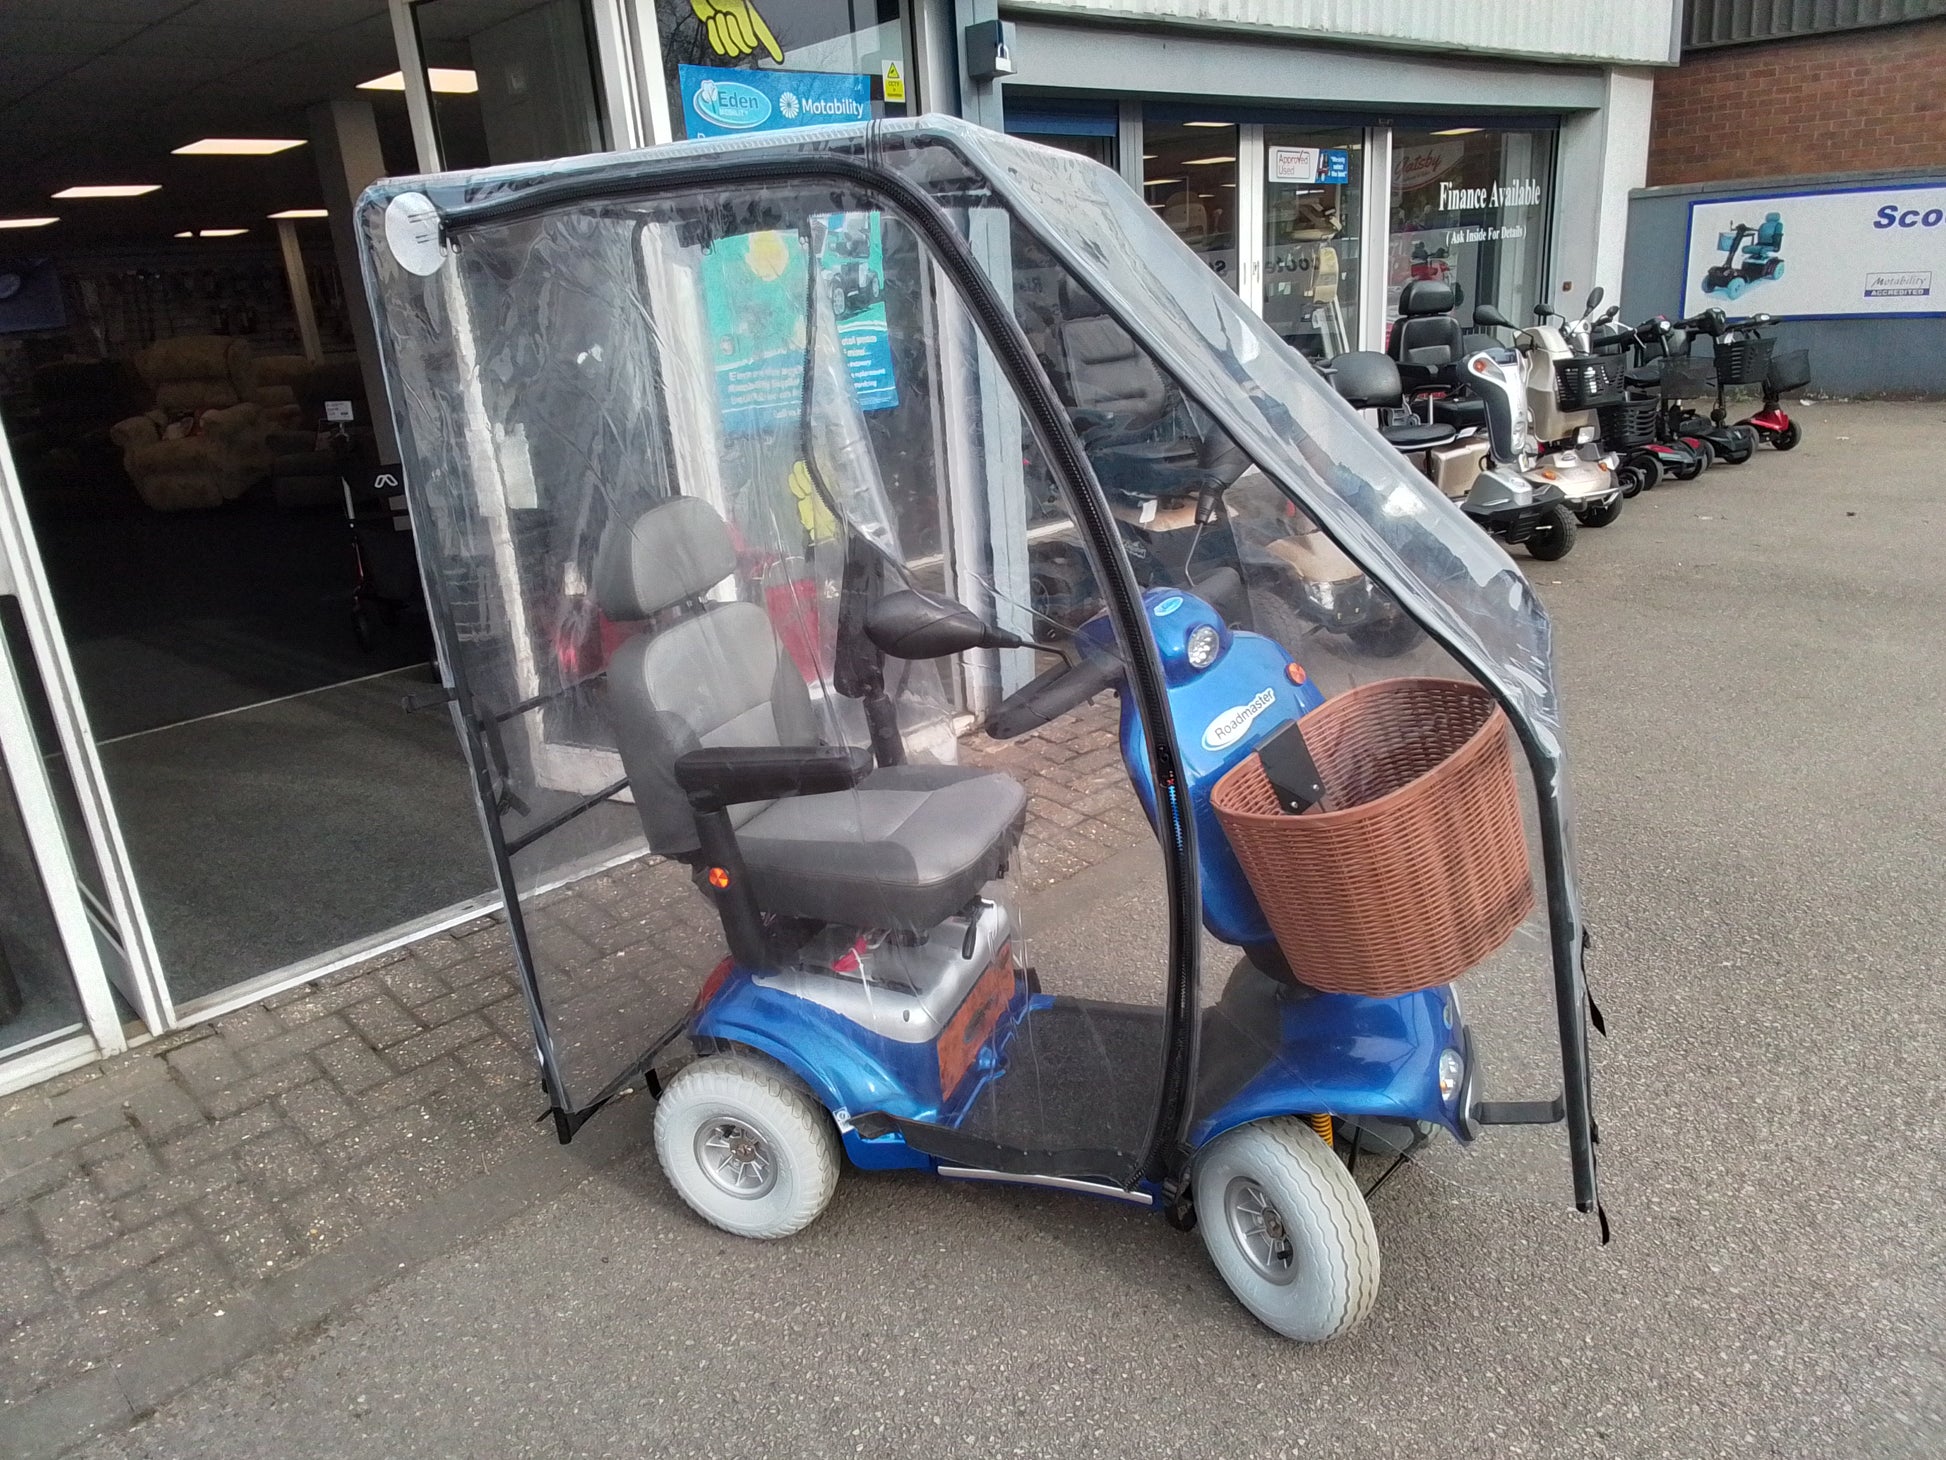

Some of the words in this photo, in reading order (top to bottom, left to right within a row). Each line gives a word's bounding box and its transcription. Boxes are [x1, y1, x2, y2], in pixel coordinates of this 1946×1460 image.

[718, 91, 759, 109] Eden
[802, 97, 864, 118] Motability
[1279, 165, 1295, 175] Used
[1438, 181, 1487, 211] Finance
[1488, 178, 1541, 208] Available
[1873, 205, 1946, 229] Sco
[1466, 227, 1487, 243] Inside
[1488, 226, 1500, 241] For
[1871, 275, 1927, 289] Motability
[1871, 288, 1924, 296] ACCREDITED
[1214, 689, 1274, 740] Roadmaster
